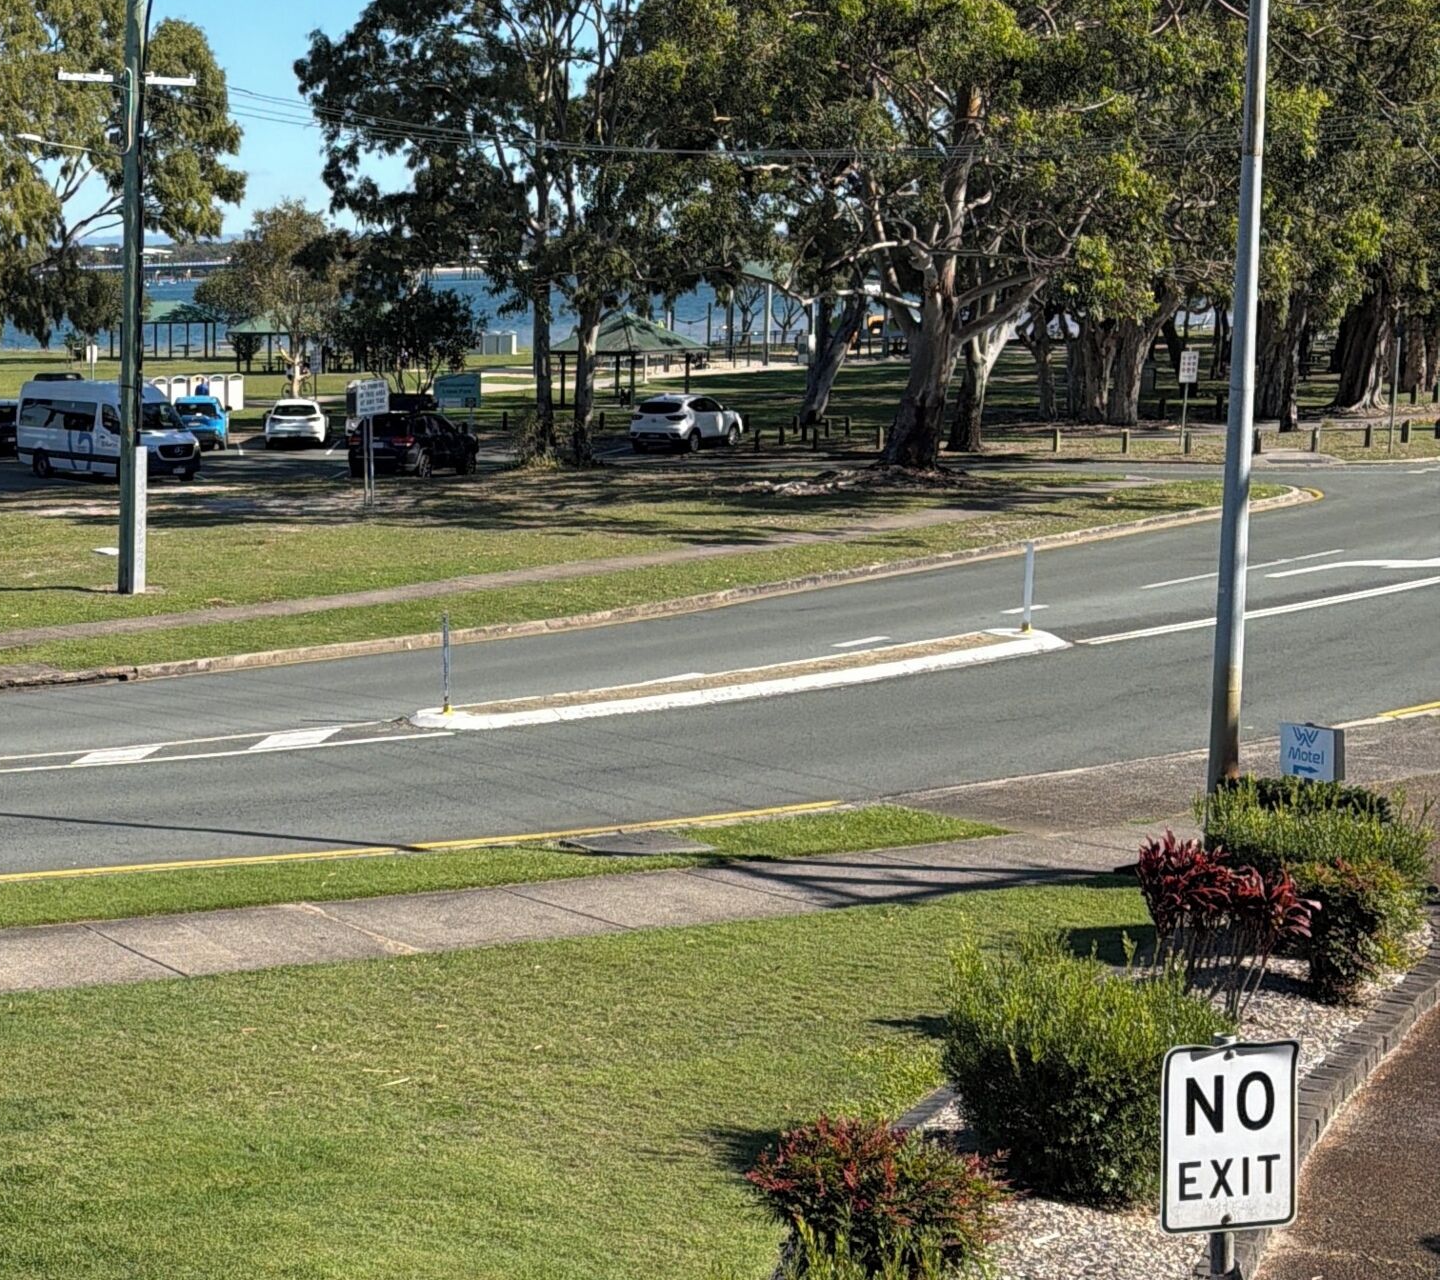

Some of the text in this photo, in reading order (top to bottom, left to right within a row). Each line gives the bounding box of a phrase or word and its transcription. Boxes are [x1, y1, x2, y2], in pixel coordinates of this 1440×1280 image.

[1288, 746, 1324, 765] Motel
[1185, 1071, 1275, 1135] NO
[1178, 1153, 1281, 1202] EXIT
